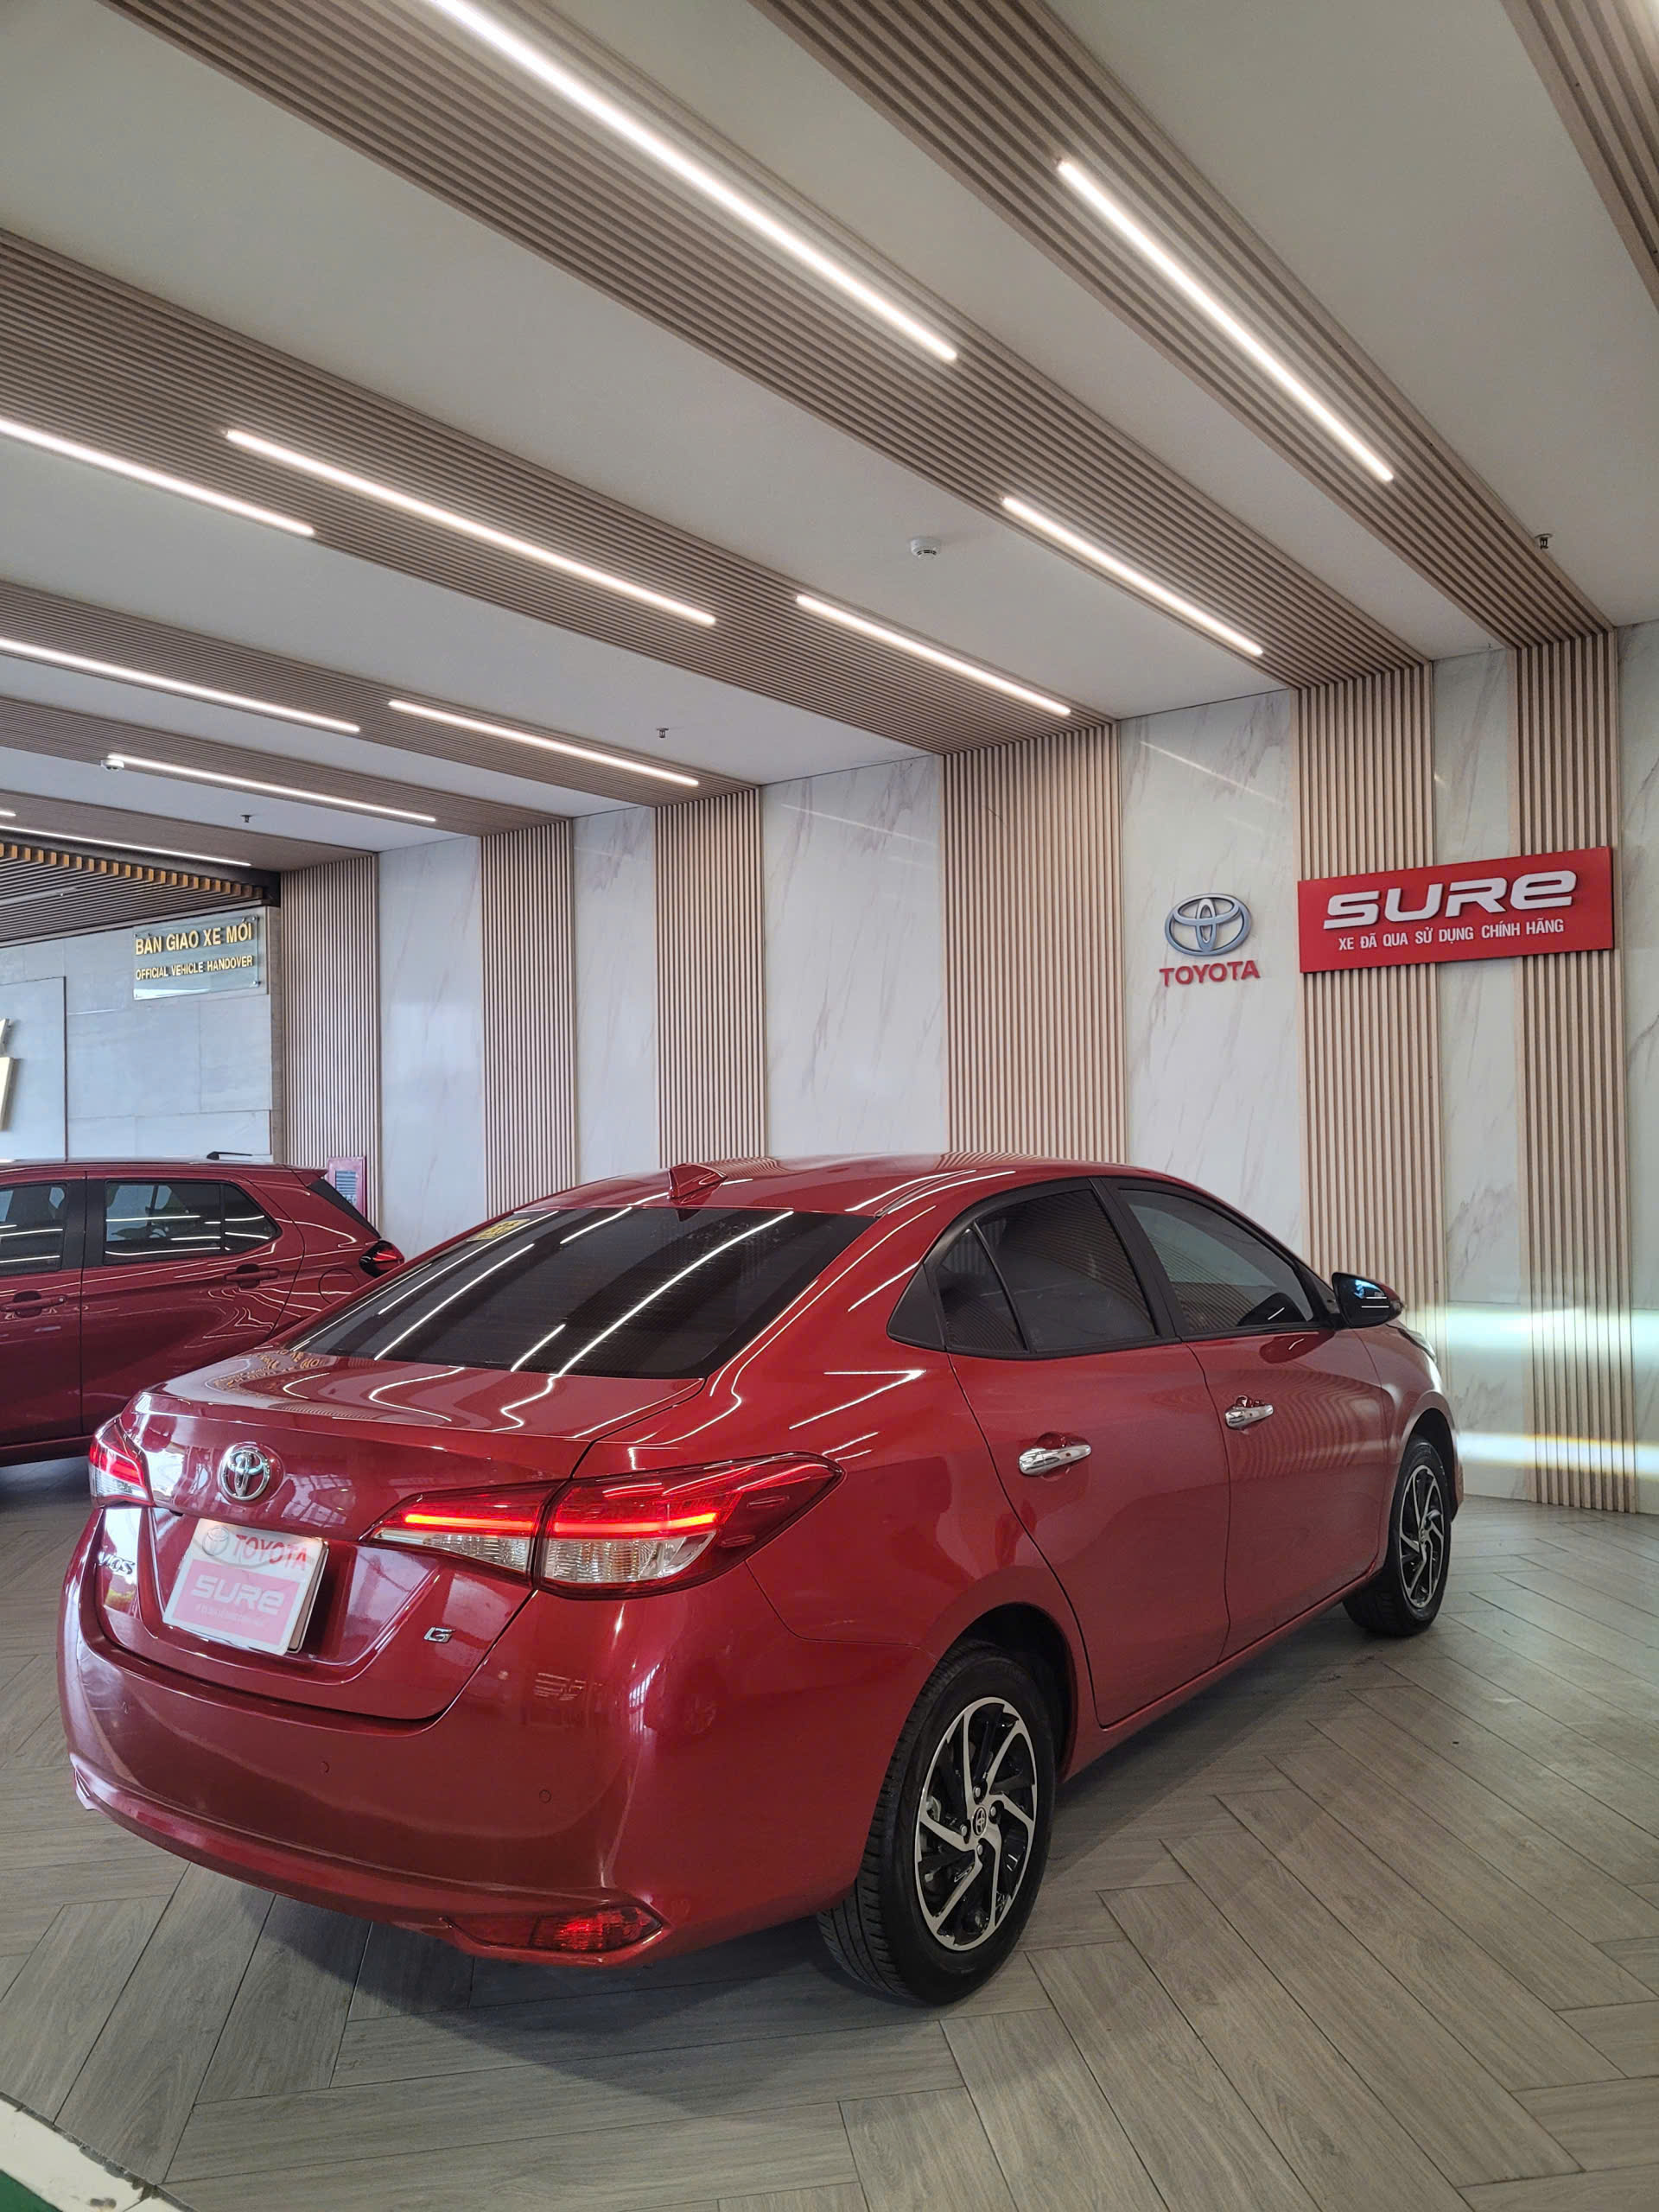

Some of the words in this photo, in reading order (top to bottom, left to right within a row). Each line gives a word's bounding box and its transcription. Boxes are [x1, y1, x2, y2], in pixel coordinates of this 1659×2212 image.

[1323, 869, 1577, 930] SURE
[166, 930, 200, 951] GIAO
[203, 927, 222, 947] XE
[1338, 937, 1355, 950] XE
[1360, 933, 1377, 949] ĐÃ
[1383, 932, 1408, 947] QUA
[1414, 926, 1433, 944] SỬ
[1439, 927, 1474, 944] DỤNG
[1481, 920, 1521, 939] CHÍNH
[1526, 918, 1564, 935] HÃNG
[136, 965, 169, 981] OFFICIAL
[171, 961, 204, 976] VEHICLE
[207, 955, 253, 972] HANDOVER
[1160, 960, 1261, 987] TOYOTA
[234, 1534, 308, 1571] TOYOTA
[192, 1573, 284, 1616] SURE
[423, 1626, 454, 1643] G
